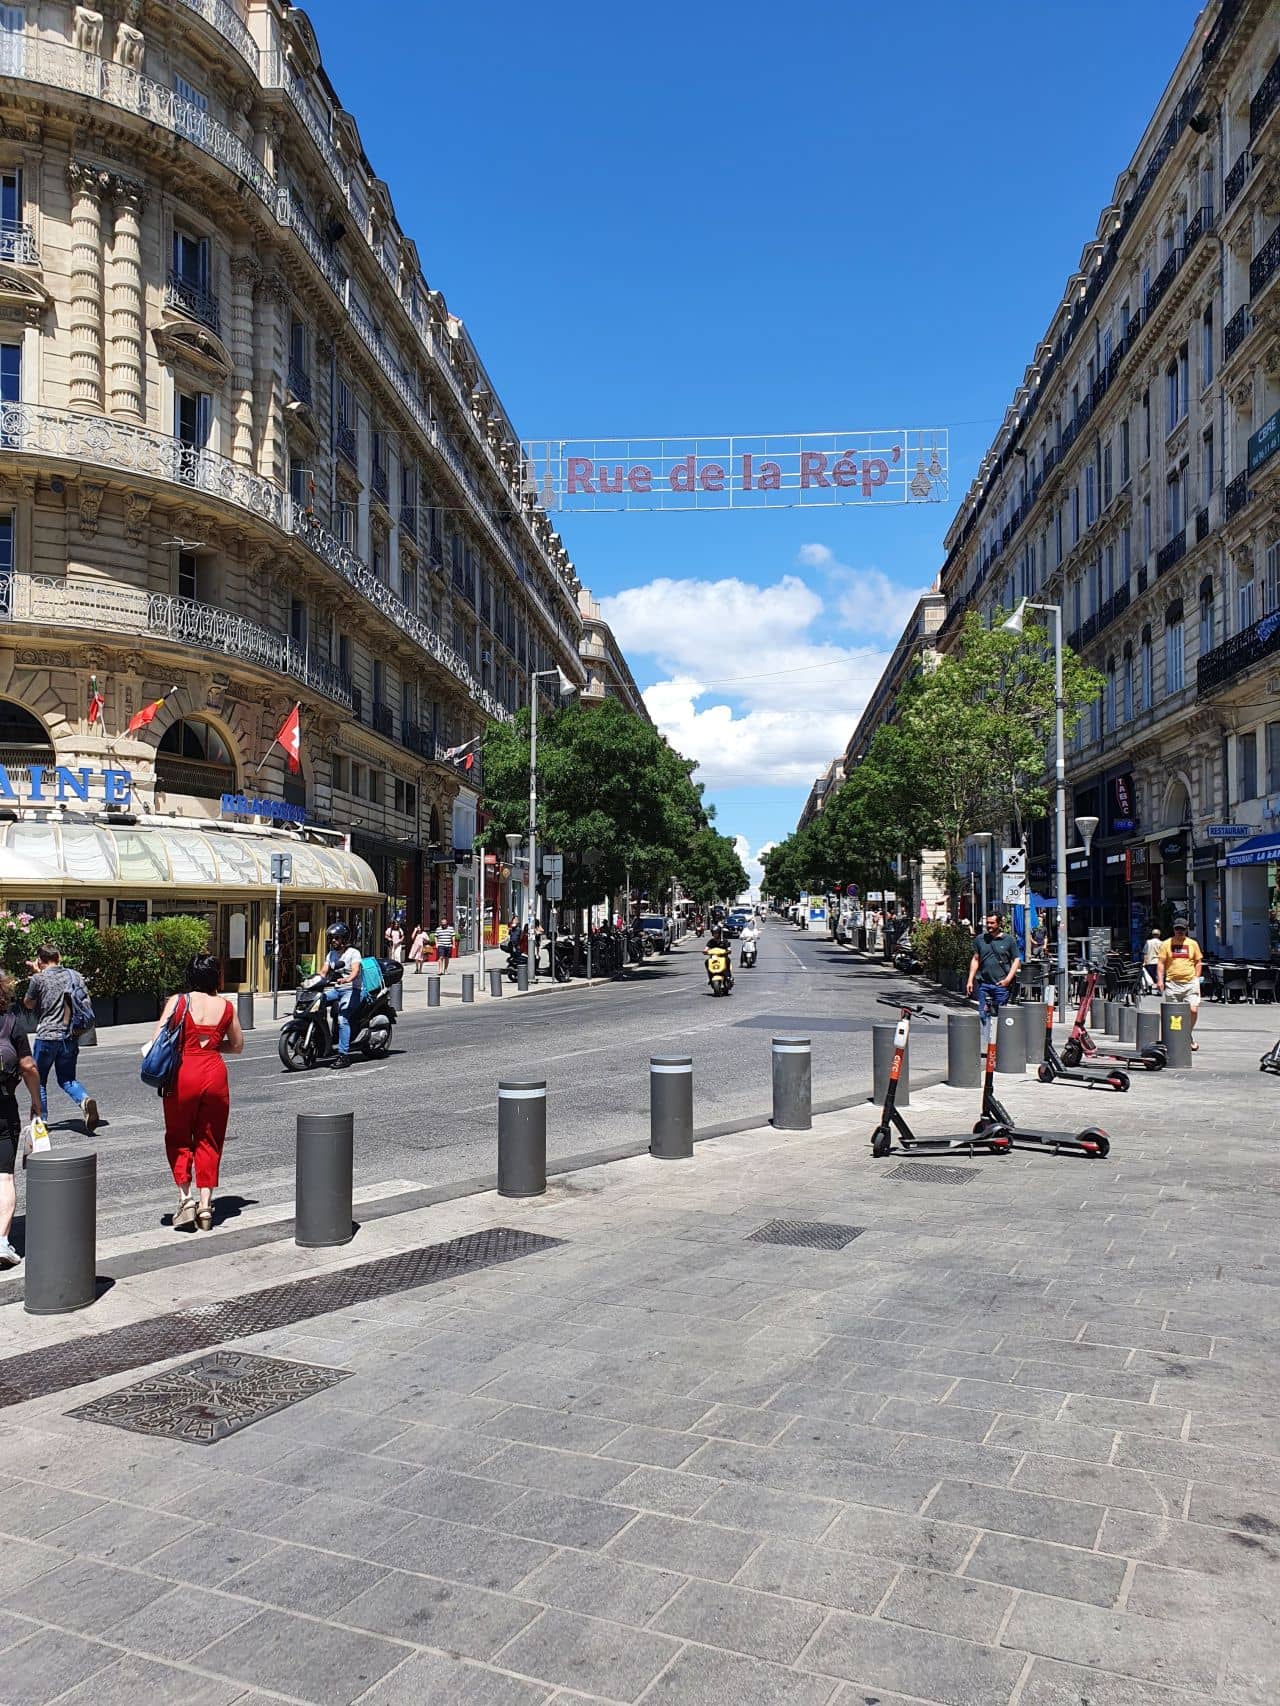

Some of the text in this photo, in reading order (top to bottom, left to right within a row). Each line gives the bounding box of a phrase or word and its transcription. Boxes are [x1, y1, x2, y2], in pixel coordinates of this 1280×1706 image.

[567, 457, 652, 494] Rue
[669, 455, 726, 492] de
[743, 454, 781, 491] la
[1118, 778, 1129, 814] TABAC
[1210, 827, 1248, 835] RESTAURANT
[891, 1054, 901, 1073] circ
